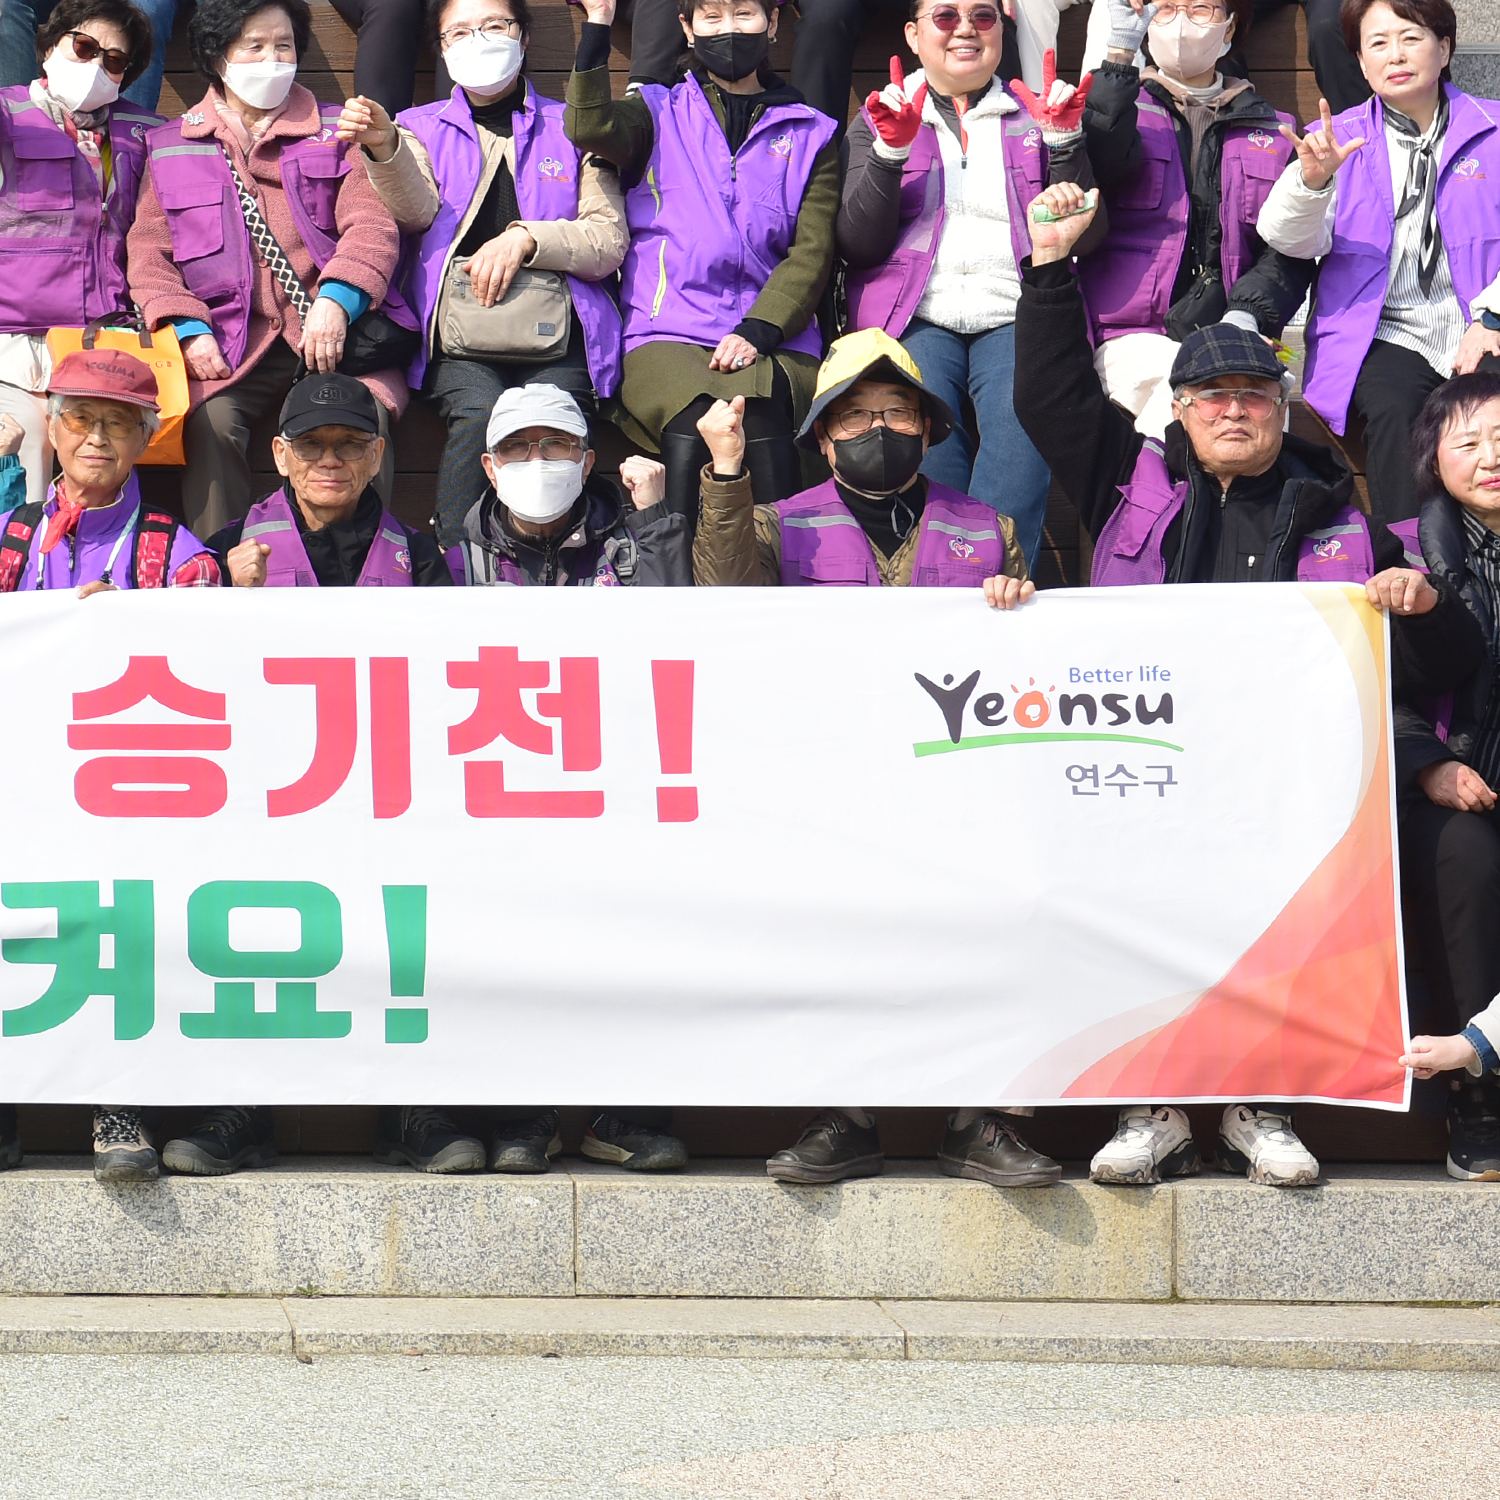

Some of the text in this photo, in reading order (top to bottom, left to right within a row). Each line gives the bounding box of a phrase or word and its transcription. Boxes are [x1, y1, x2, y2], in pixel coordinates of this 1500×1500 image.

[1069, 664, 1171, 683] Better life
[914, 669, 1174, 744] Yeonsu
[67, 646, 699, 823] 승기천!
[1064, 764, 1179, 798] 연수구
